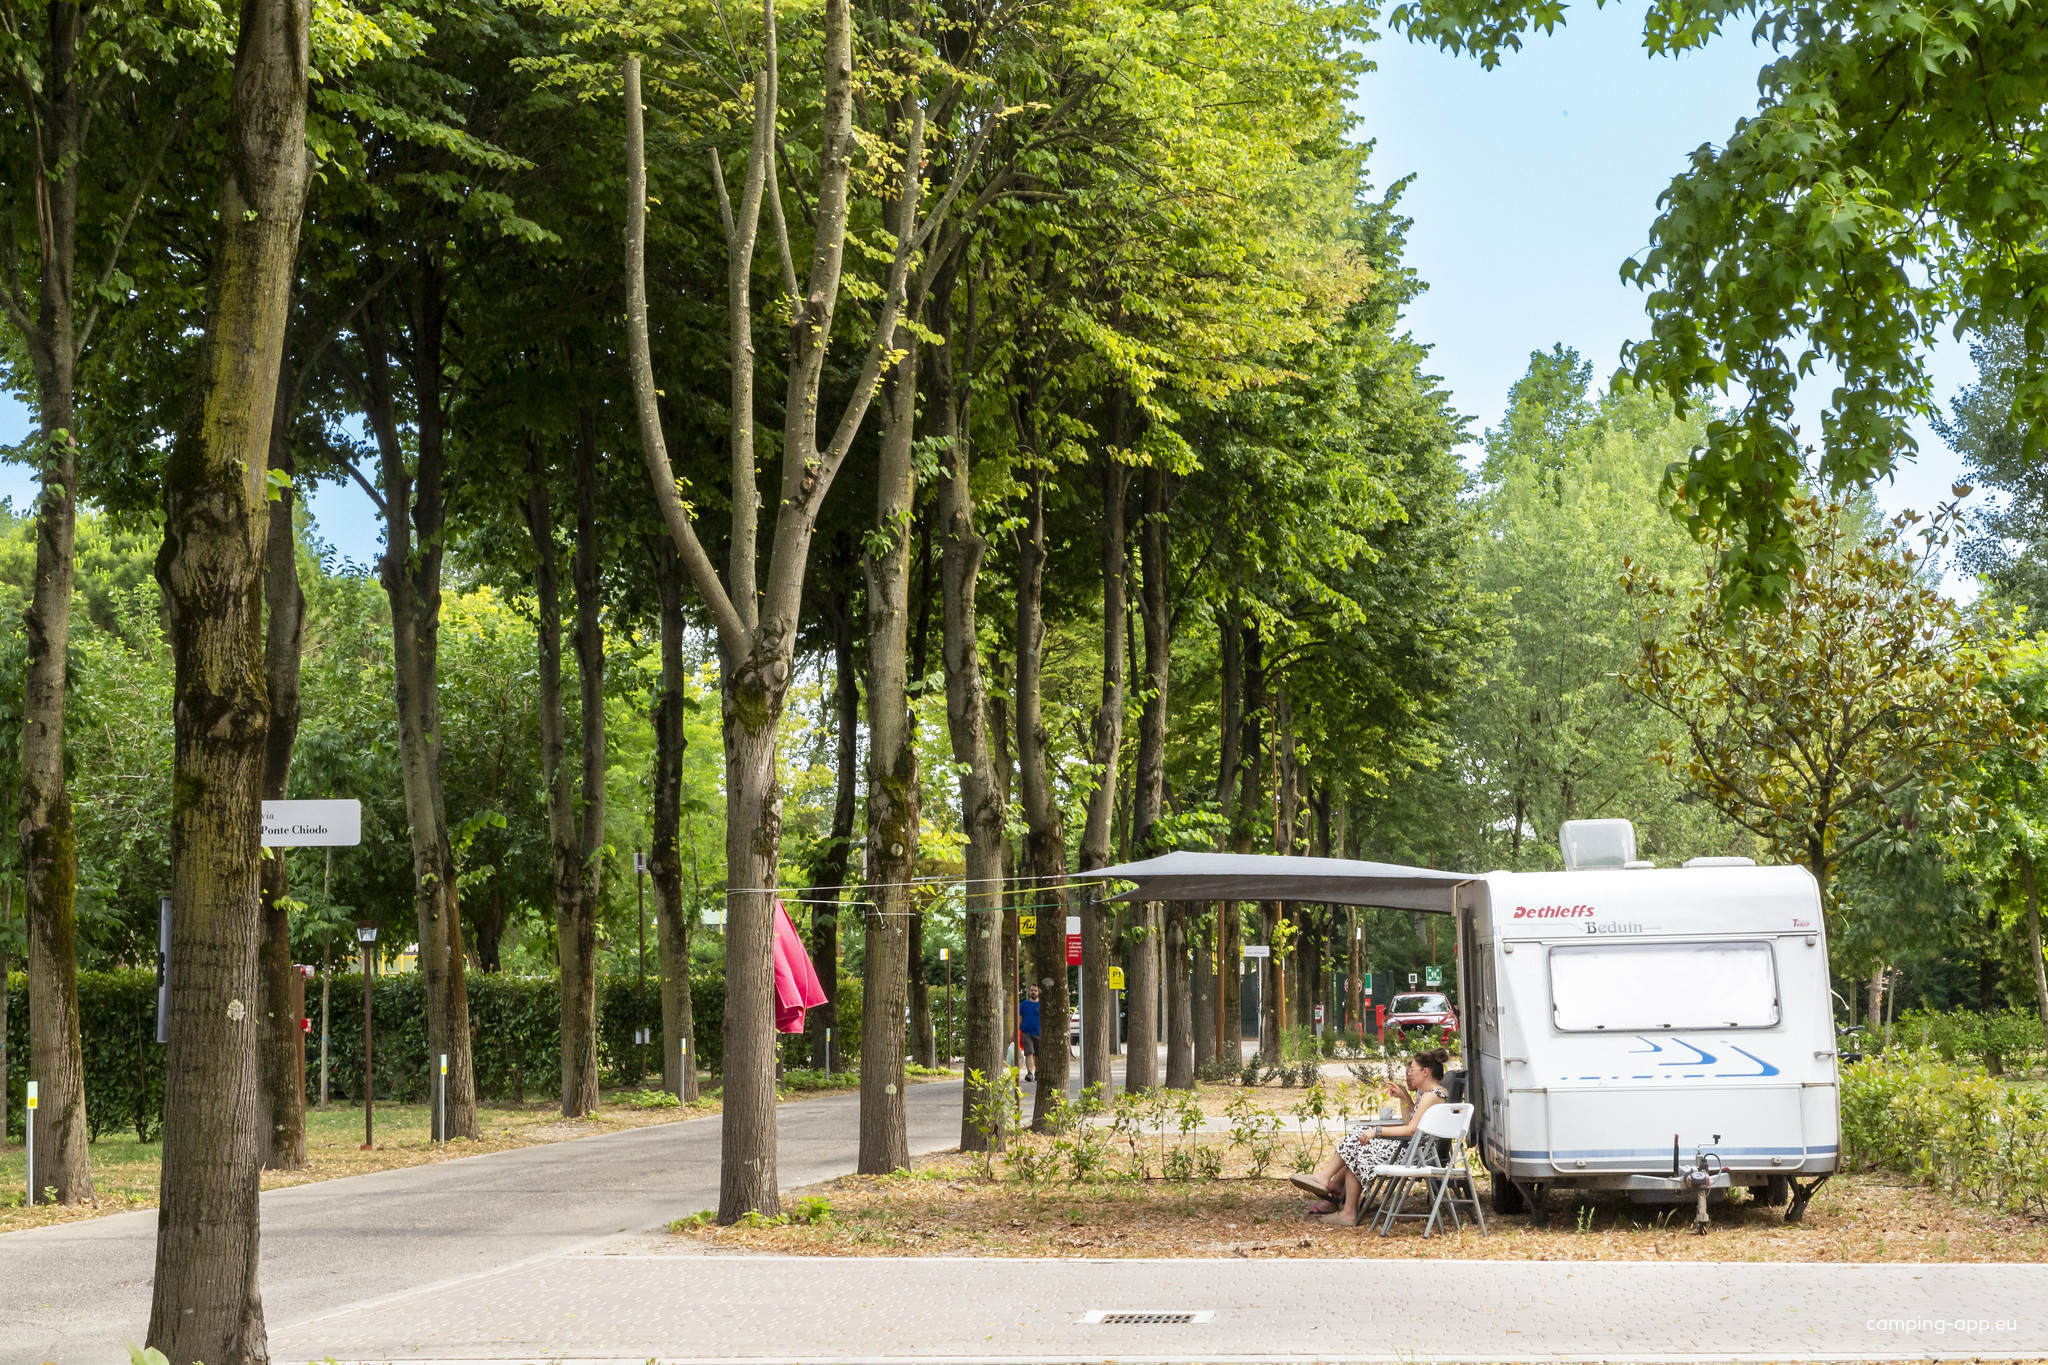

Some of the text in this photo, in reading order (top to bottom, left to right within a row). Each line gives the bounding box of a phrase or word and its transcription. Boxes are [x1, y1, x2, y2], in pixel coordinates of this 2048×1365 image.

[261, 811, 274, 820] via
[261, 825, 328, 835] Ponte Chiodo
[1513, 905, 1595, 919] Dethleffs
[1585, 921, 1643, 934] Beduin
